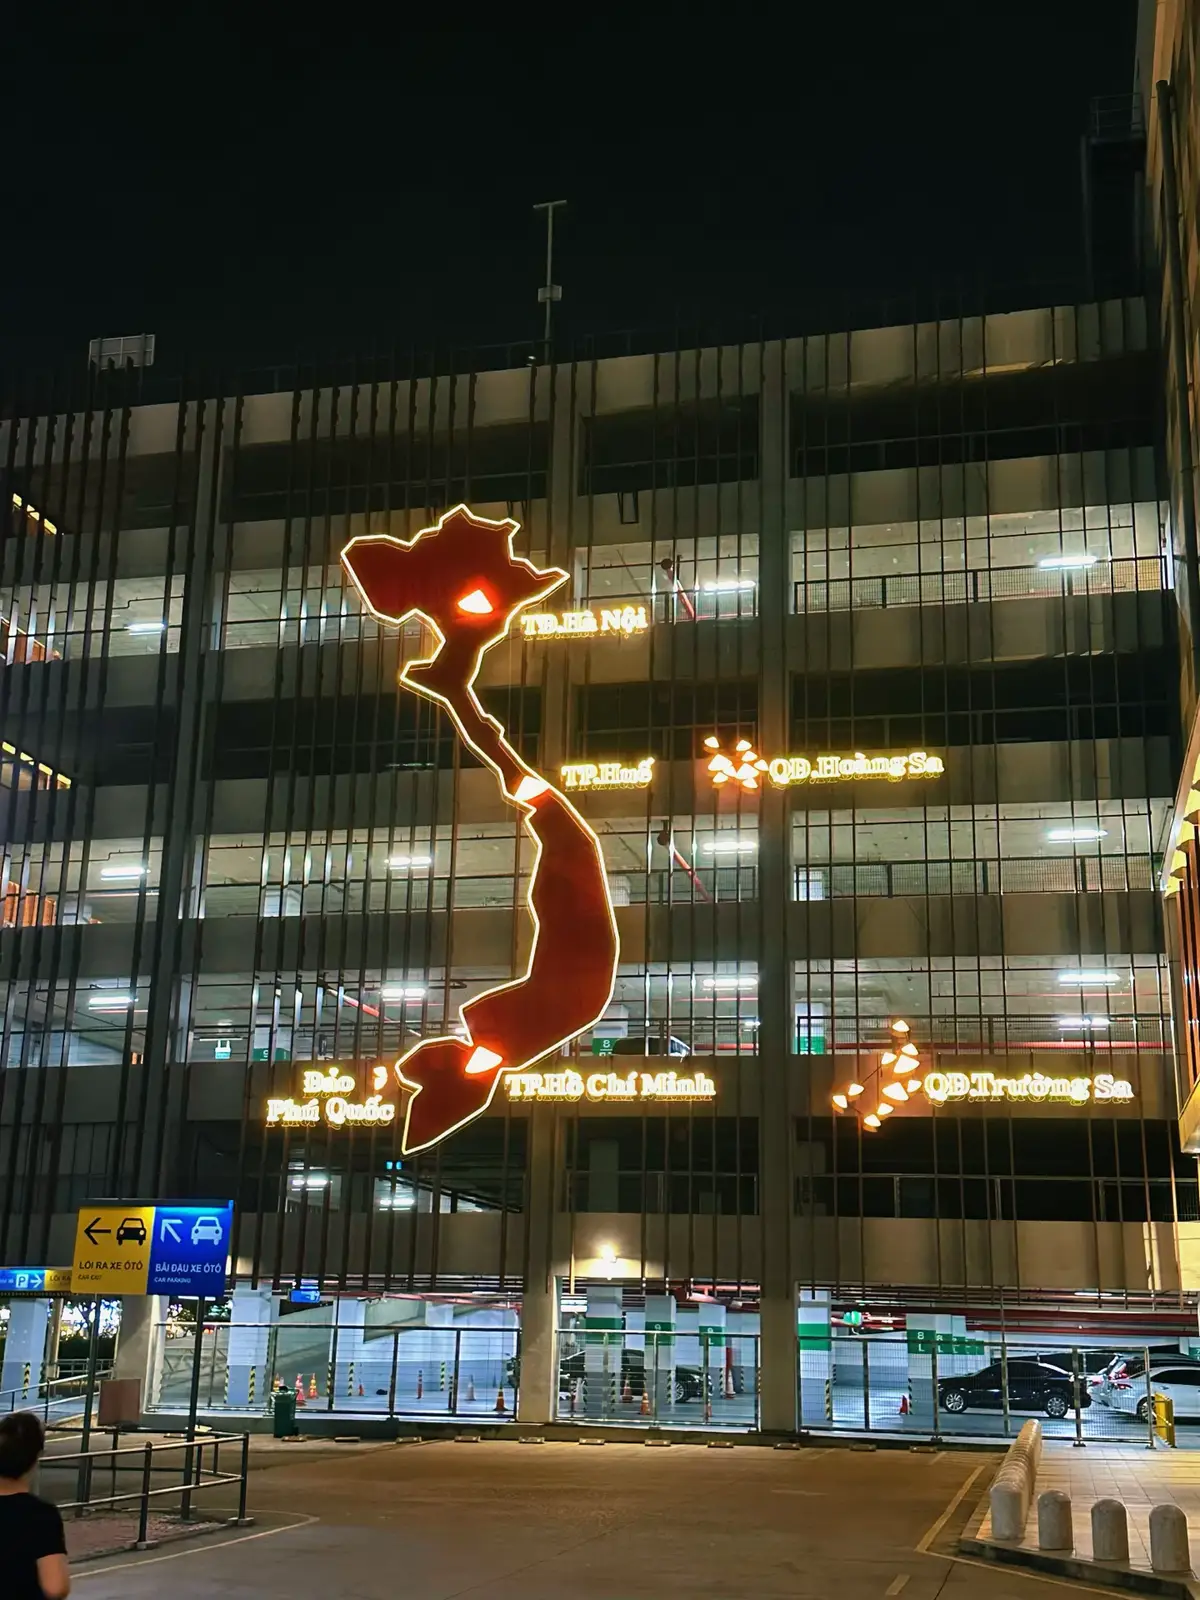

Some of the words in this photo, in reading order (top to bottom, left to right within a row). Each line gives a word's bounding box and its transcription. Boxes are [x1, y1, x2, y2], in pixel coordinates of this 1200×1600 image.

[601, 605, 648, 633] Nội
[908, 752, 945, 774] Sa
[303, 1067, 356, 1093] Đảo
[586, 1071, 638, 1097] Chí
[640, 1071, 716, 1097] Minh
[1093, 1073, 1135, 1099] Sa
[266, 1098, 320, 1122] Phú
[325, 1094, 395, 1125] Quốc
[96, 1261, 108, 1270] RA
[110, 1261, 122, 1270] XE
[190, 1264, 202, 1273] XE
